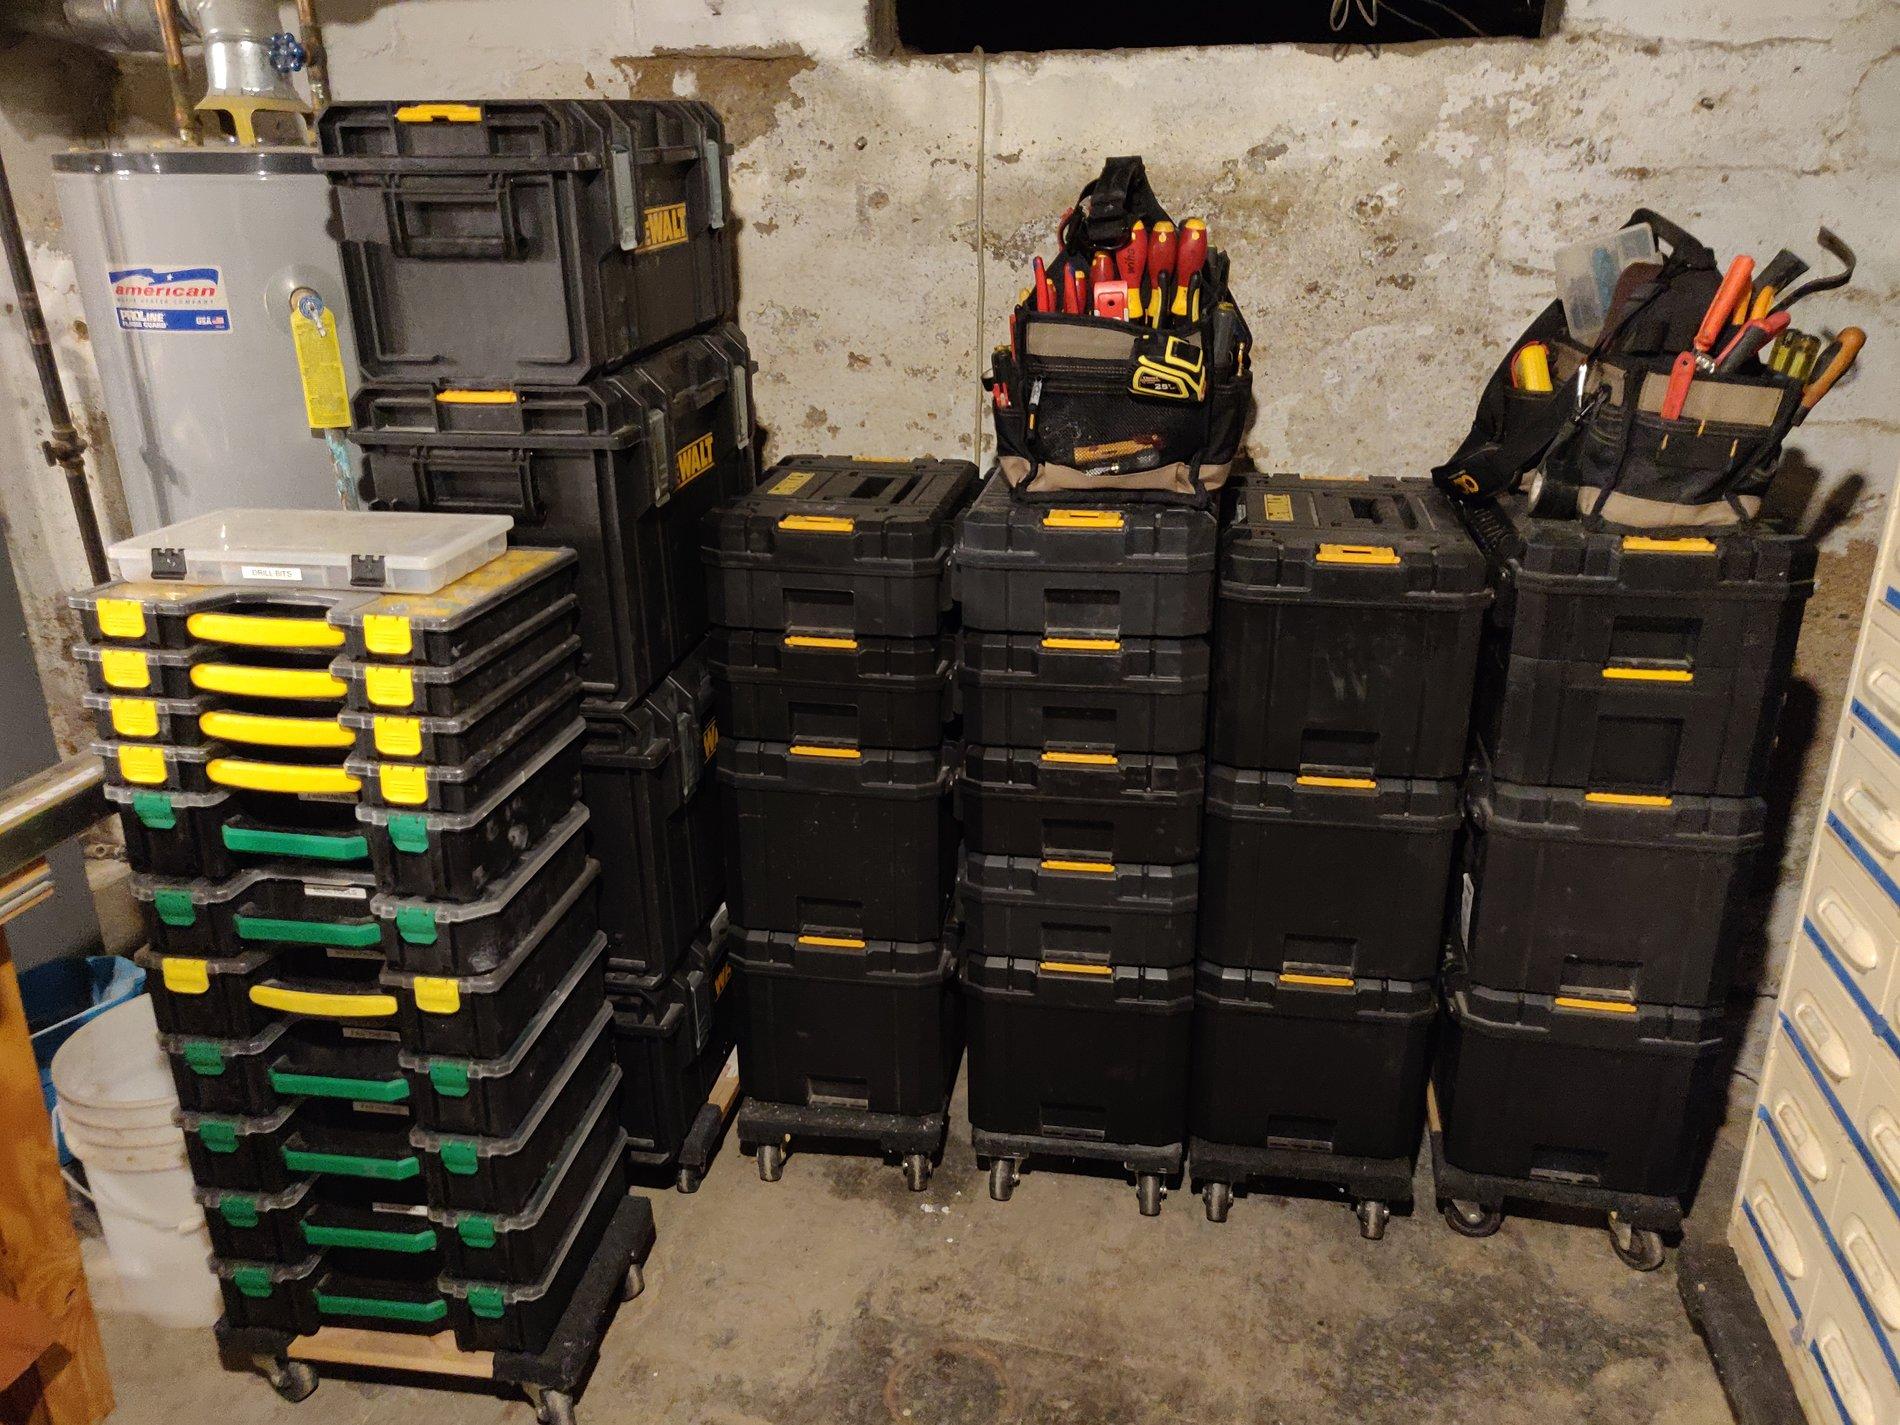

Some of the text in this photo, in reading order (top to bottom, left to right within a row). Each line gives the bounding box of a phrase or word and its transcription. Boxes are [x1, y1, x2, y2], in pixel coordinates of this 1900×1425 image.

[644, 205, 687, 246] EWALT
[115, 285, 216, 297] american
[676, 435, 713, 482] WALT
[252, 569, 292, 577] DRILL BITS
